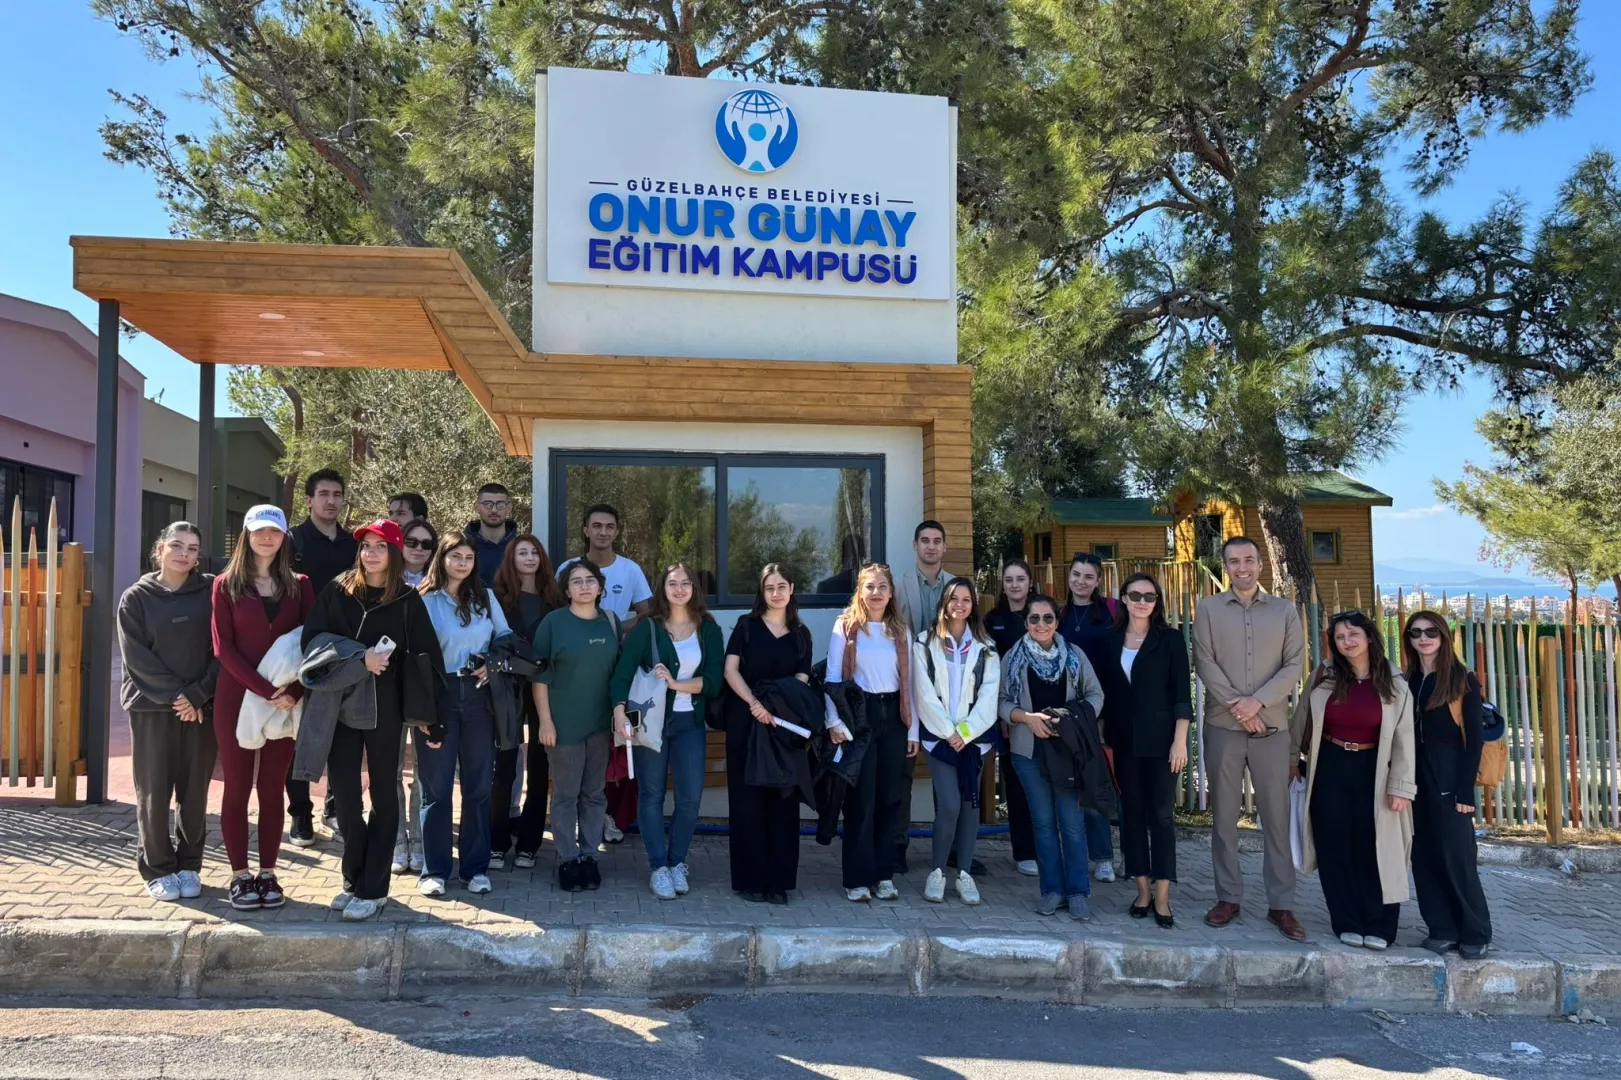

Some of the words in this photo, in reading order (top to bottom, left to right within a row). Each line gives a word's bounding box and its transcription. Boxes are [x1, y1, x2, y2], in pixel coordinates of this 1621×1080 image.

[626, 177, 758, 201] GÜZELBAHÇE
[767, 188, 880, 206] BELEDİYESİ
[588, 192, 736, 239] ONUR
[747, 202, 917, 249] GÜNAY
[588, 235, 720, 276] EĞİTİM
[733, 246, 917, 286] KAMPÜSÜ
